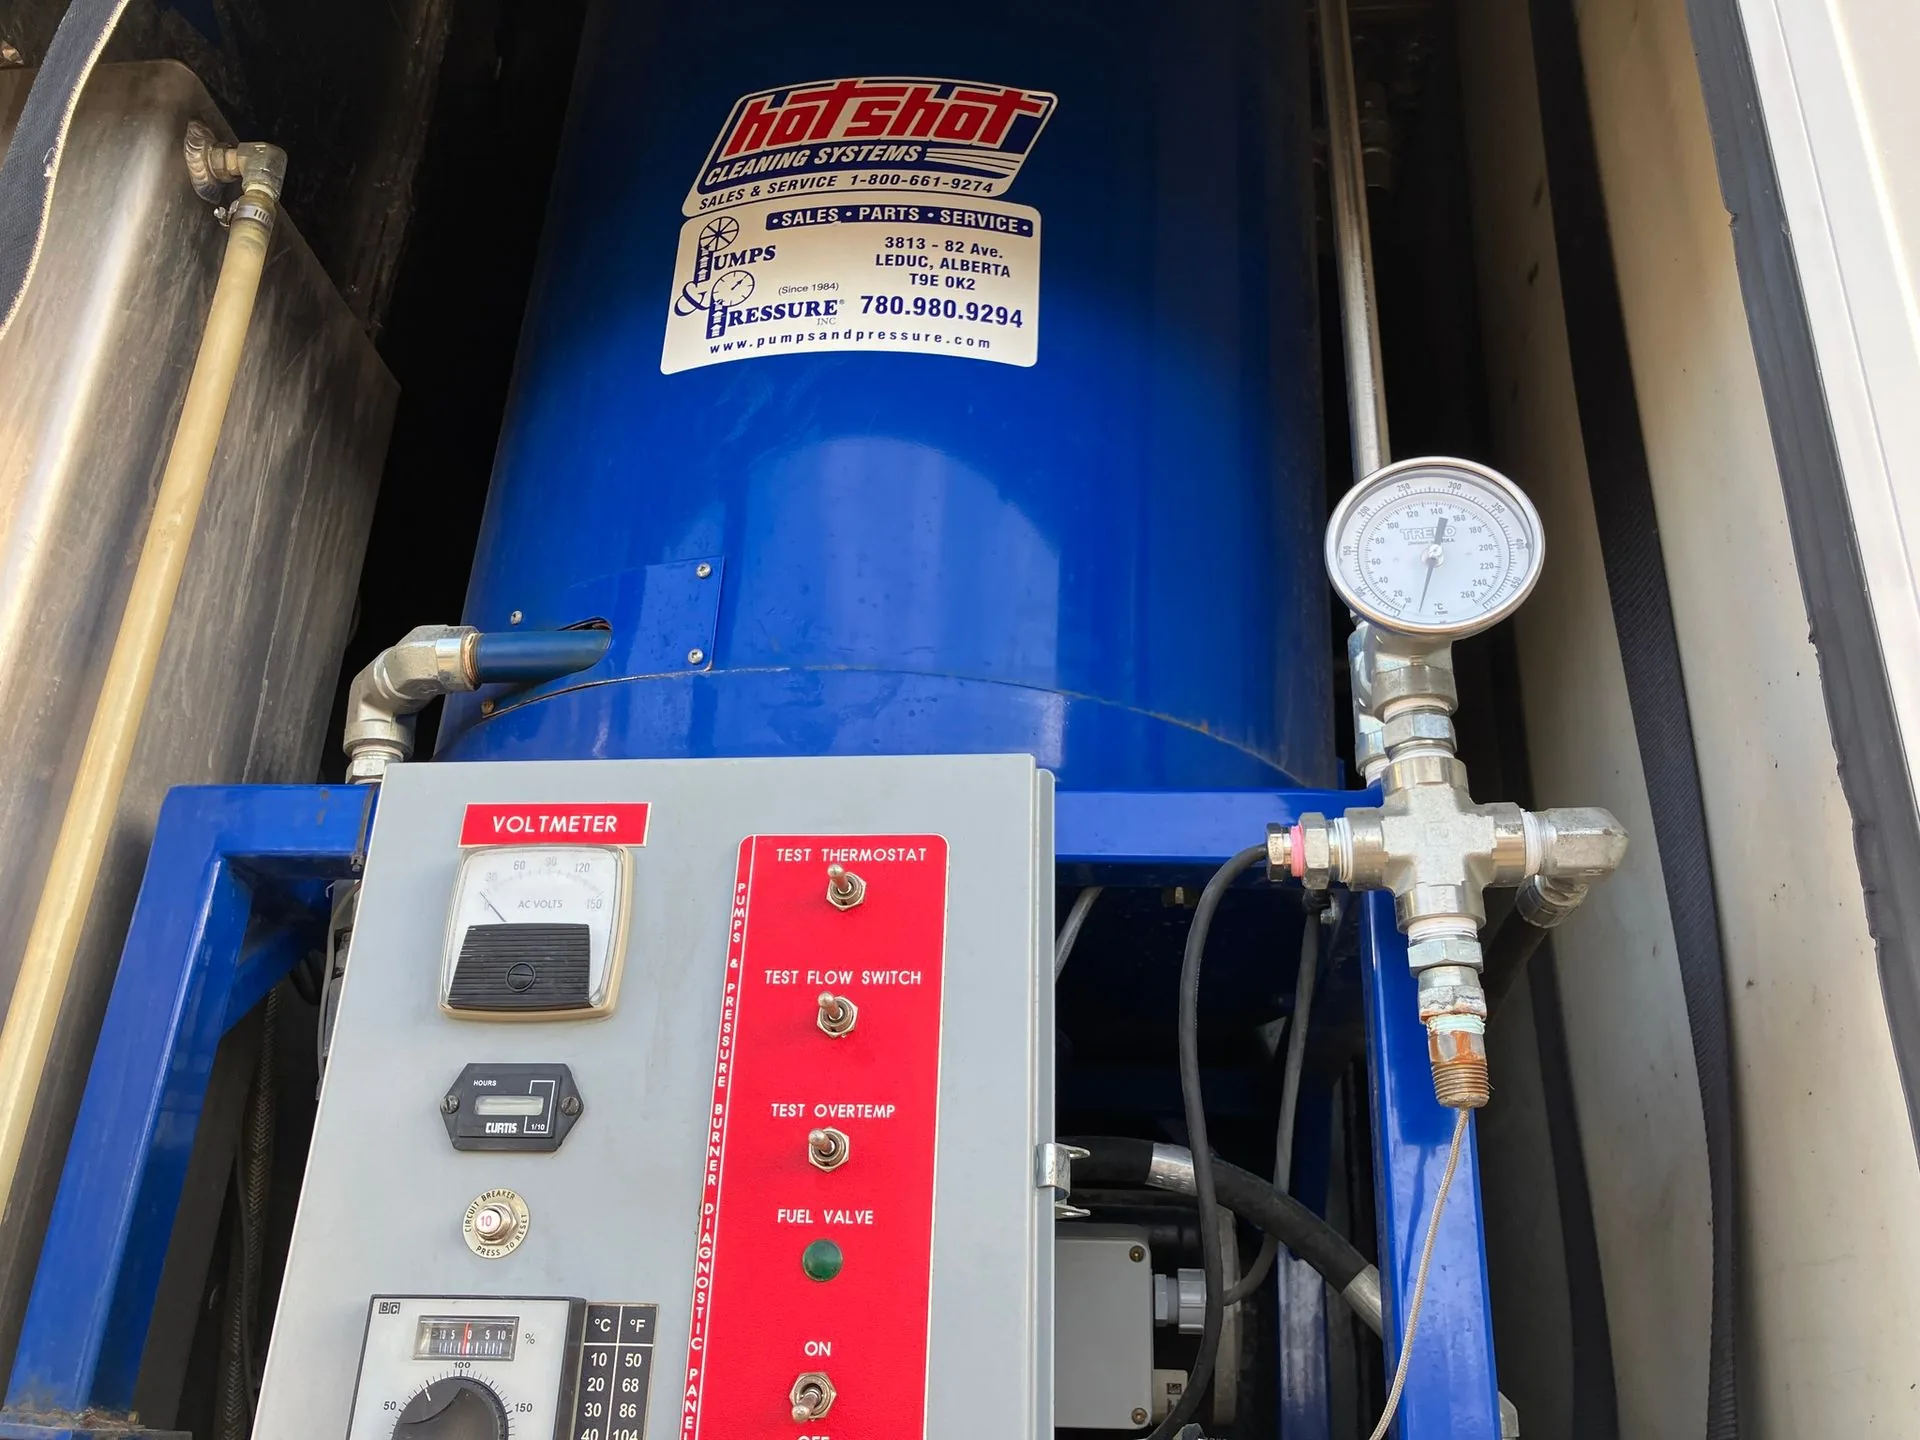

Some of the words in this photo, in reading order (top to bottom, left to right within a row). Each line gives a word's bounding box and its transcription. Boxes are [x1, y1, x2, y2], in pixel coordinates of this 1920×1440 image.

[704, 148, 808, 186] CLEANING
[814, 145, 923, 165] SYSTEMS
[699, 188, 744, 210] SALES
[750, 185, 761, 197] &
[767, 175, 838, 195] SERVICE
[850, 174, 994, 194] 1-800-661-9274
[781, 208, 839, 226] SALES
[859, 207, 920, 222] PARTS
[940, 209, 1020, 233] SERVICE
[884, 236, 926, 251] 3813
[944, 240, 966, 254] 82
[970, 242, 1004, 259] Ave.
[875, 253, 935, 270] LEDUC,
[939, 259, 1011, 278] ALBERTA
[908, 273, 939, 287] T9E
[778, 286, 809, 296] (Since
[812, 282, 840, 292] 1984)
[674, 280, 717, 317] &
[860, 295, 1024, 328] 780.980.9294
[816, 317, 838, 326] INC
[709, 329, 991, 354] www.pumpsandpressure.com
[1396, 483, 1411, 492] 250
[1453, 514, 1466, 522] 160
[1469, 526, 1482, 534] 180
[1479, 543, 1493, 551] 200
[1480, 562, 1494, 570] 220
[1472, 579, 1487, 587] 240
[1460, 591, 1475, 599] 260
[492, 815, 618, 833] VOLTMETER
[776, 848, 811, 862] TEST
[821, 848, 927, 862] THERMOSTAT
[513, 860, 526, 871] 60
[575, 862, 591, 873] 120
[518, 900, 532, 909] AC
[534, 900, 563, 909] VOLTS
[586, 899, 602, 909] 150
[732, 882, 746, 943] PUMPS
[729, 958, 738, 969] &
[764, 970, 799, 985] TEST
[806, 970, 853, 985] FLOW
[861, 970, 922, 985] SWITCH
[717, 983, 736, 1087] PRESSURE
[473, 1079, 497, 1087] HOURS
[771, 1103, 806, 1118] TEST
[813, 1103, 896, 1119] OVERTEMP
[485, 1122, 518, 1134] CURTIS
[706, 1103, 723, 1186] BURNER
[464, 1201, 480, 1233] CIRCUIT
[481, 1190, 515, 1202] BREAKER
[777, 1209, 814, 1224] FUEL
[823, 1209, 874, 1225] VALVE
[480, 1215, 493, 1227] 10
[475, 1245, 501, 1257] PRESS
[505, 1241, 515, 1251] TO
[515, 1214, 528, 1242] RESET
[690, 1202, 714, 1351] DIAGNOSTIC
[378, 1302, 400, 1315] BC
[594, 1318, 611, 1333] °C
[629, 1319, 646, 1333] °F
[450, 1329, 456, 1340] 5
[485, 1329, 490, 1340] 5
[497, 1329, 506, 1340] 10
[524, 1333, 536, 1345] %
[804, 1340, 832, 1357] ON
[453, 1361, 471, 1369] 100
[591, 1352, 608, 1367] 10
[624, 1353, 642, 1367] 50
[587, 1377, 604, 1392] 20
[622, 1378, 639, 1392] 68
[383, 1401, 397, 1411] 50
[514, 1402, 533, 1413] 150
[584, 1403, 602, 1417] 30
[619, 1403, 637, 1418] 86
[581, 1428, 599, 1440] 40
[612, 1429, 638, 1440] 104
